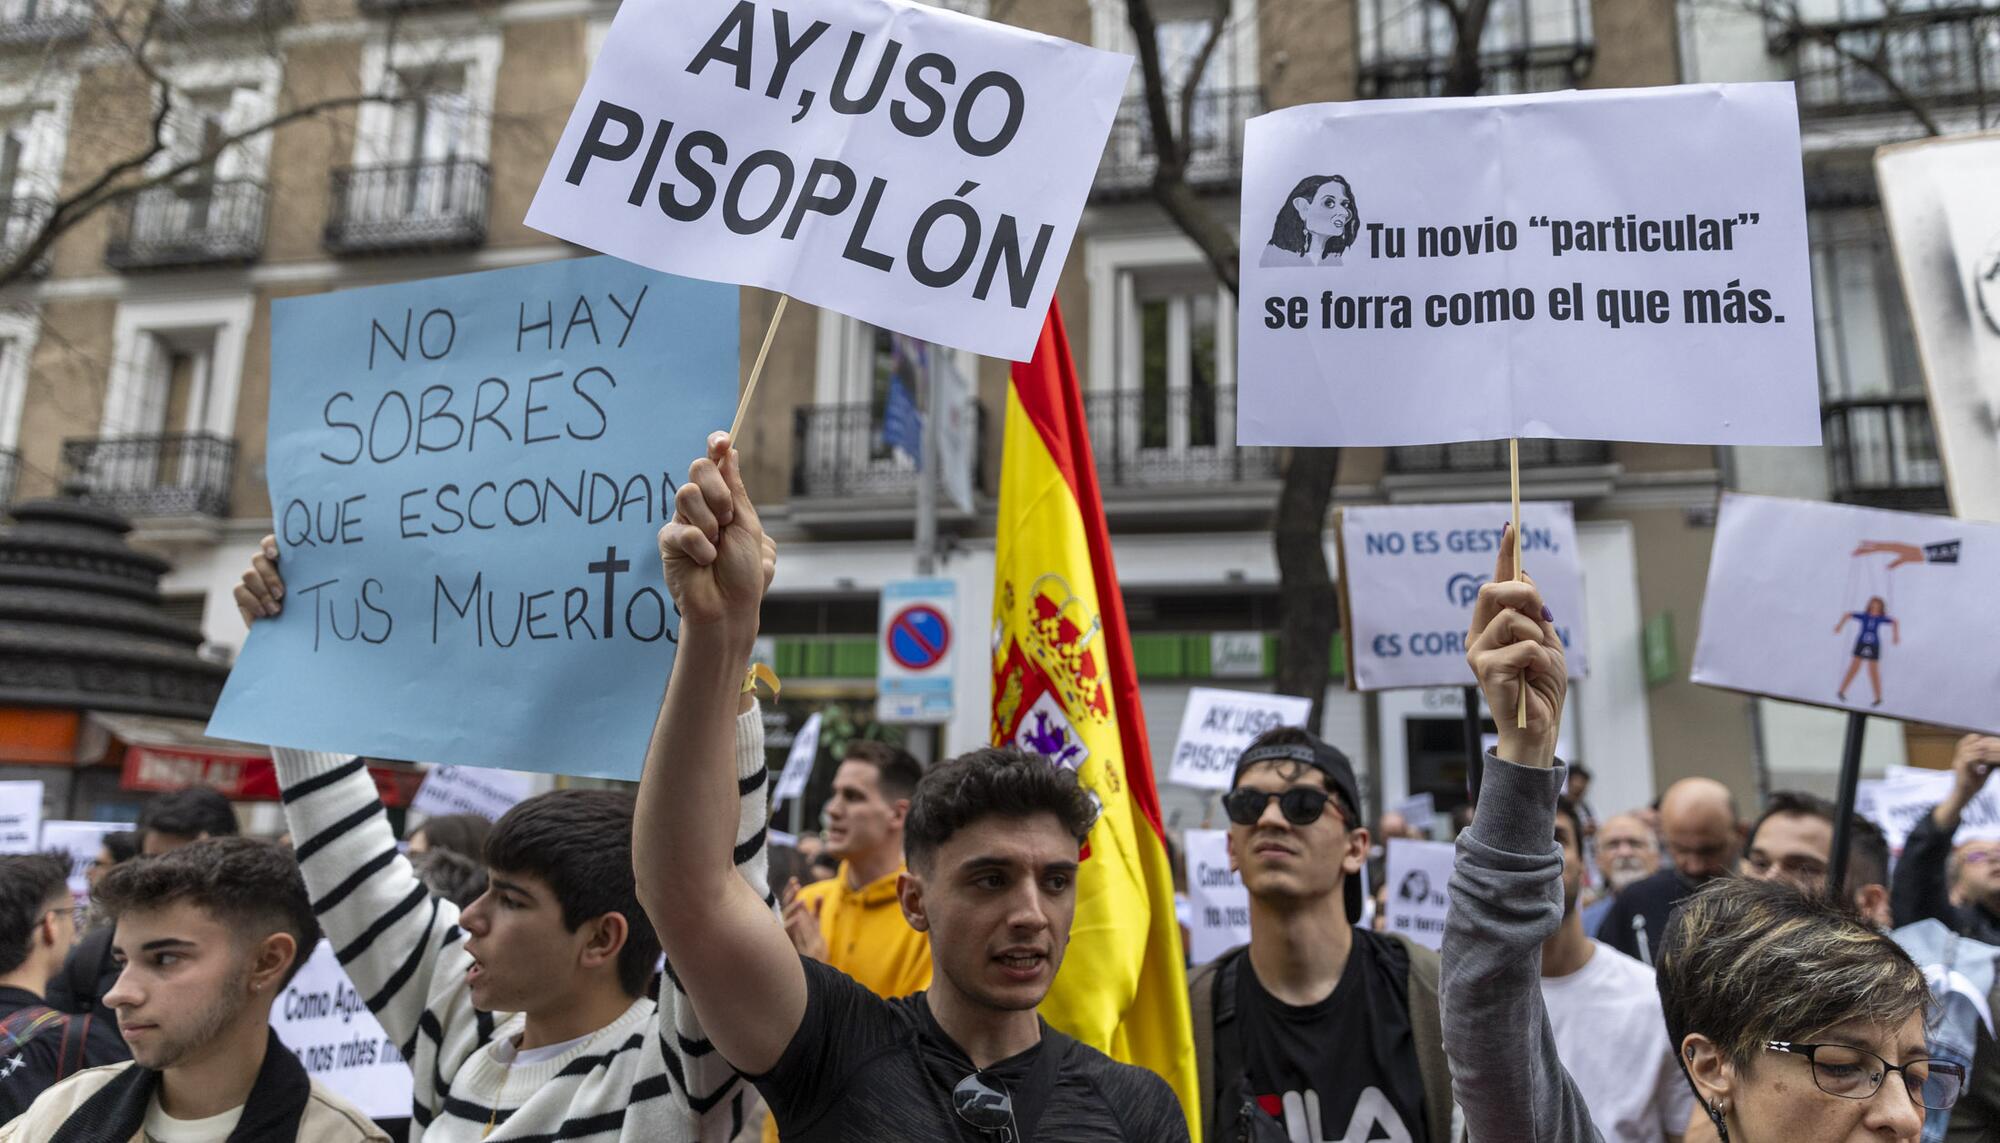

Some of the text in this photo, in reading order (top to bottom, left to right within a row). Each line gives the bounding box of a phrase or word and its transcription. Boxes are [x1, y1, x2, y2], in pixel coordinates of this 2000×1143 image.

[685, 0, 1025, 157] AY,USO
[565, 100, 1055, 309] PISOPLÓN
[1366, 222, 1412, 258] Tu
[1417, 216, 1517, 258] novio
[368, 285, 648, 371] NO HAY
[1264, 279, 1786, 329] se forra como el que más.
[320, 366, 616, 465] SOBRES
[283, 494, 367, 547] QUE
[1366, 521, 1560, 554] NO ES GESTÓN,
[297, 578, 393, 652] TUS
[284, 986, 330, 1021] Como
